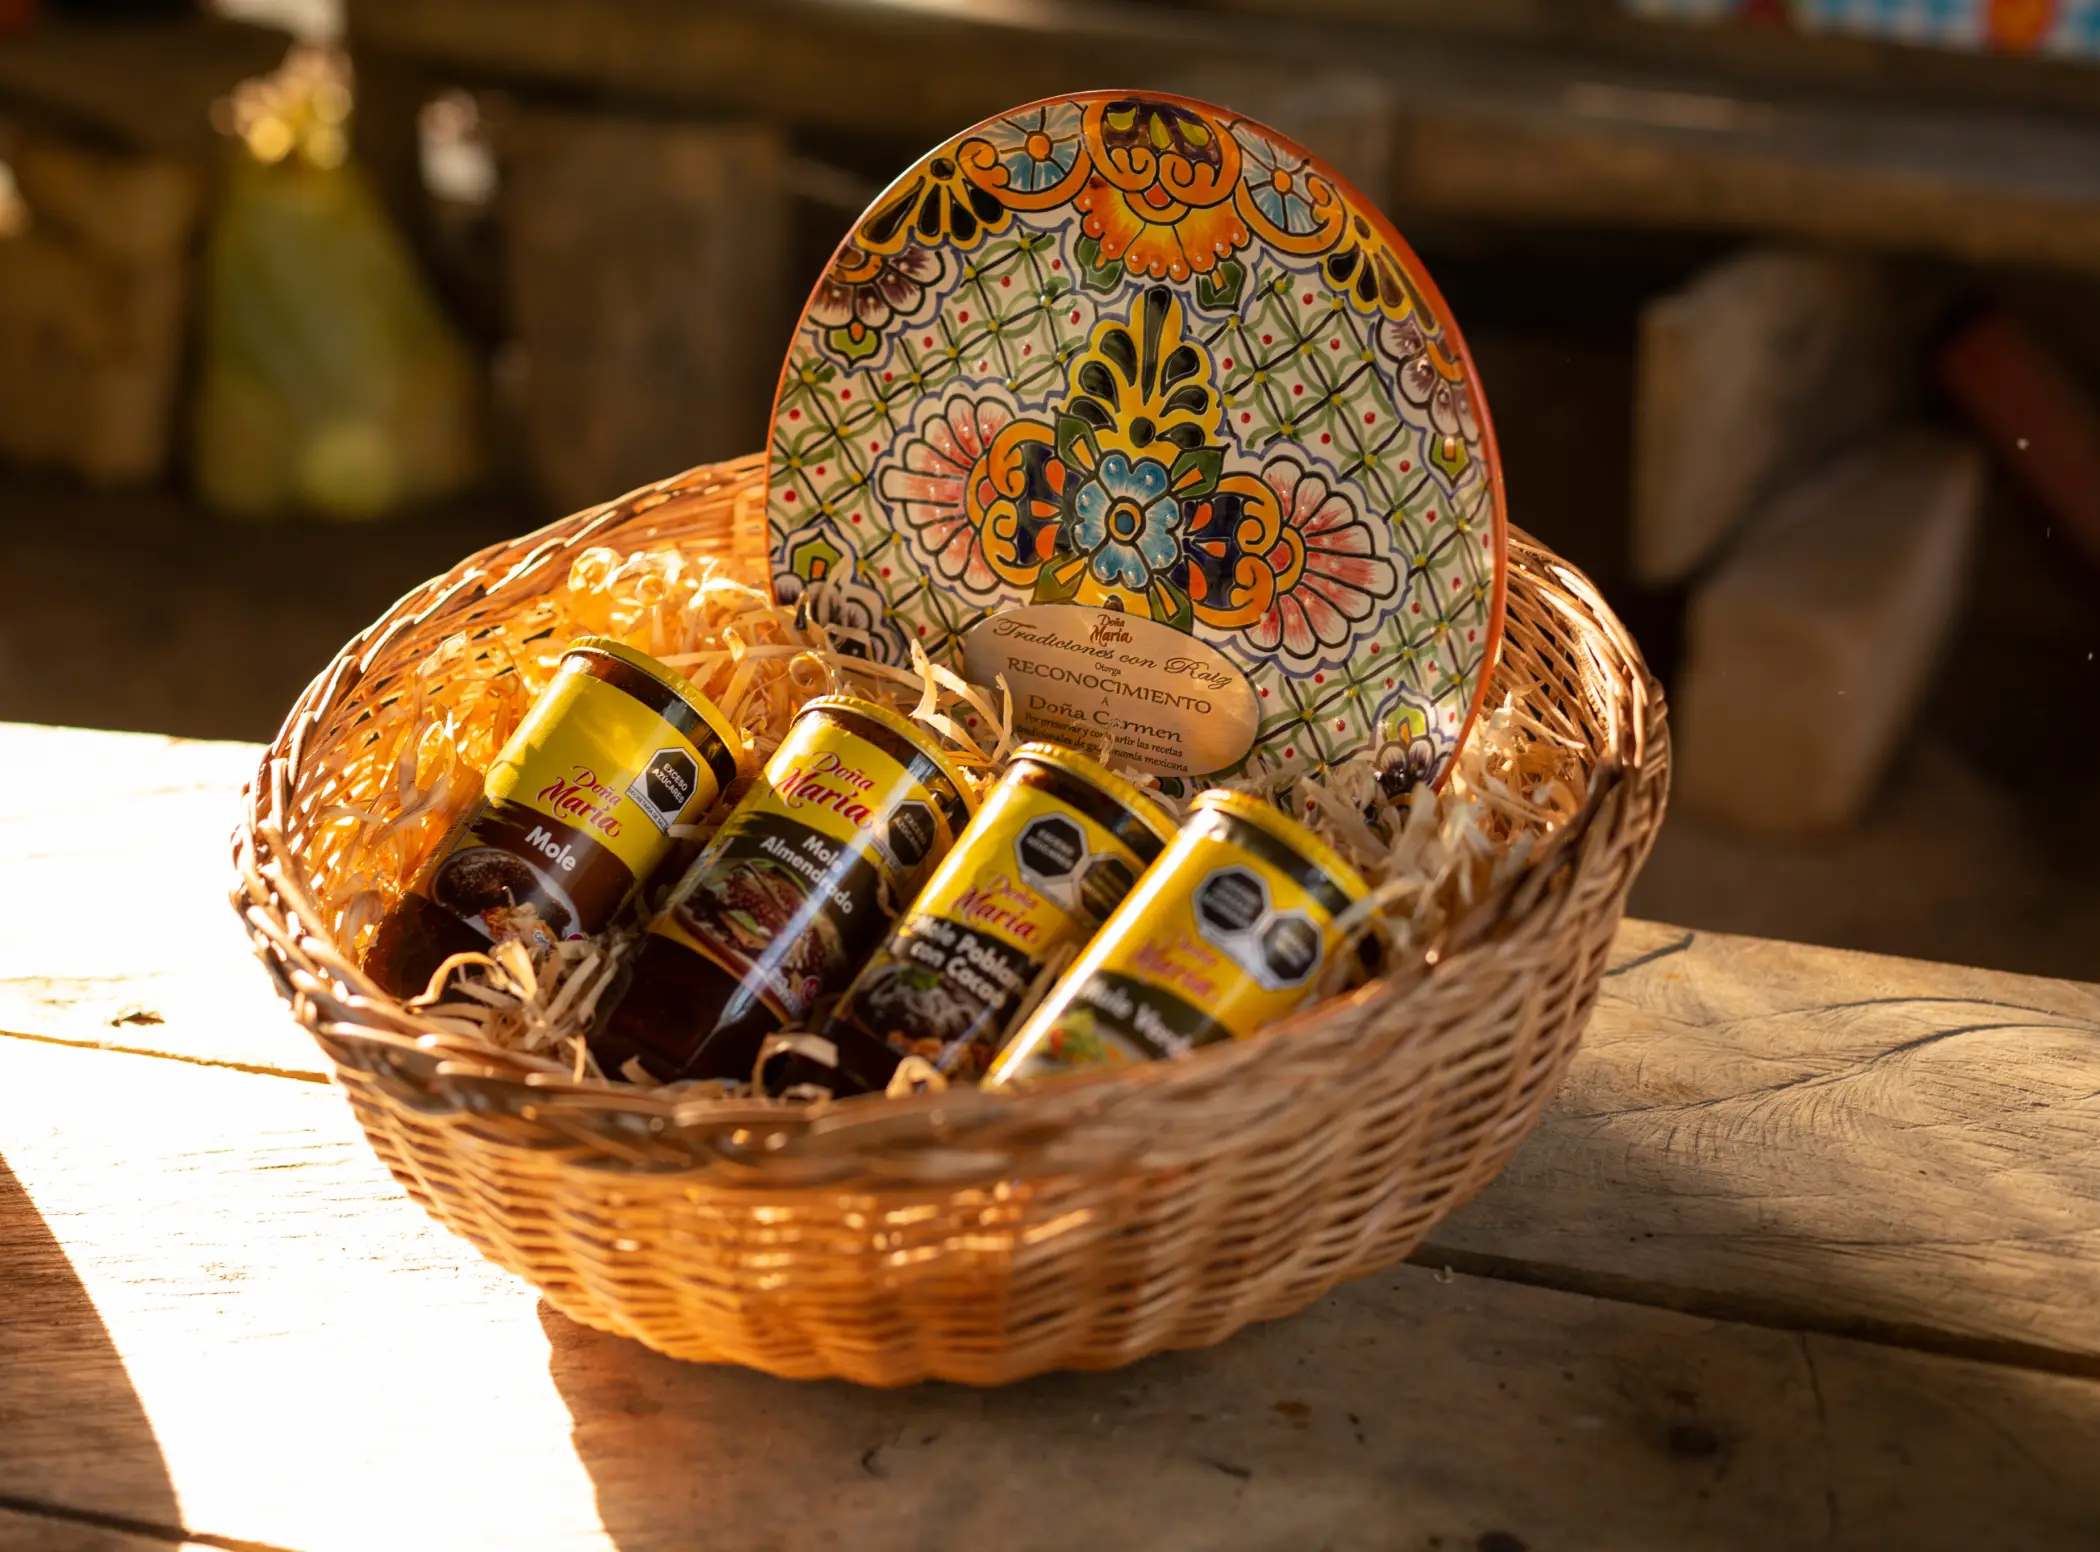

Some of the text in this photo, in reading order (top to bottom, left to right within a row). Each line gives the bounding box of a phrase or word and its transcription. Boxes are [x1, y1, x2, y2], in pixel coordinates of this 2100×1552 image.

[1097, 613, 1126, 628] Doña
[992, 617, 1115, 660] Tradiciones
[1119, 653, 1158, 669] con
[1006, 656, 1212, 714] RECONOCIMIENTO
[1094, 661, 1122, 677] Otorga
[1028, 694, 1086, 721] Doña
[1101, 696, 1109, 707] A
[1090, 730, 1135, 746] coartir
[1137, 737, 1150, 750] las
[1151, 744, 1183, 758] recetas
[663, 763, 688, 791] EXCESO
[810, 751, 876, 792] Doña
[1144, 756, 1188, 773] mexicana
[570, 765, 622, 806] Doña
[652, 768, 685, 804] AZÚCARES
[524, 825, 577, 872] Mole
[802, 834, 844, 874] Mole
[759, 835, 854, 915] Almendrado
